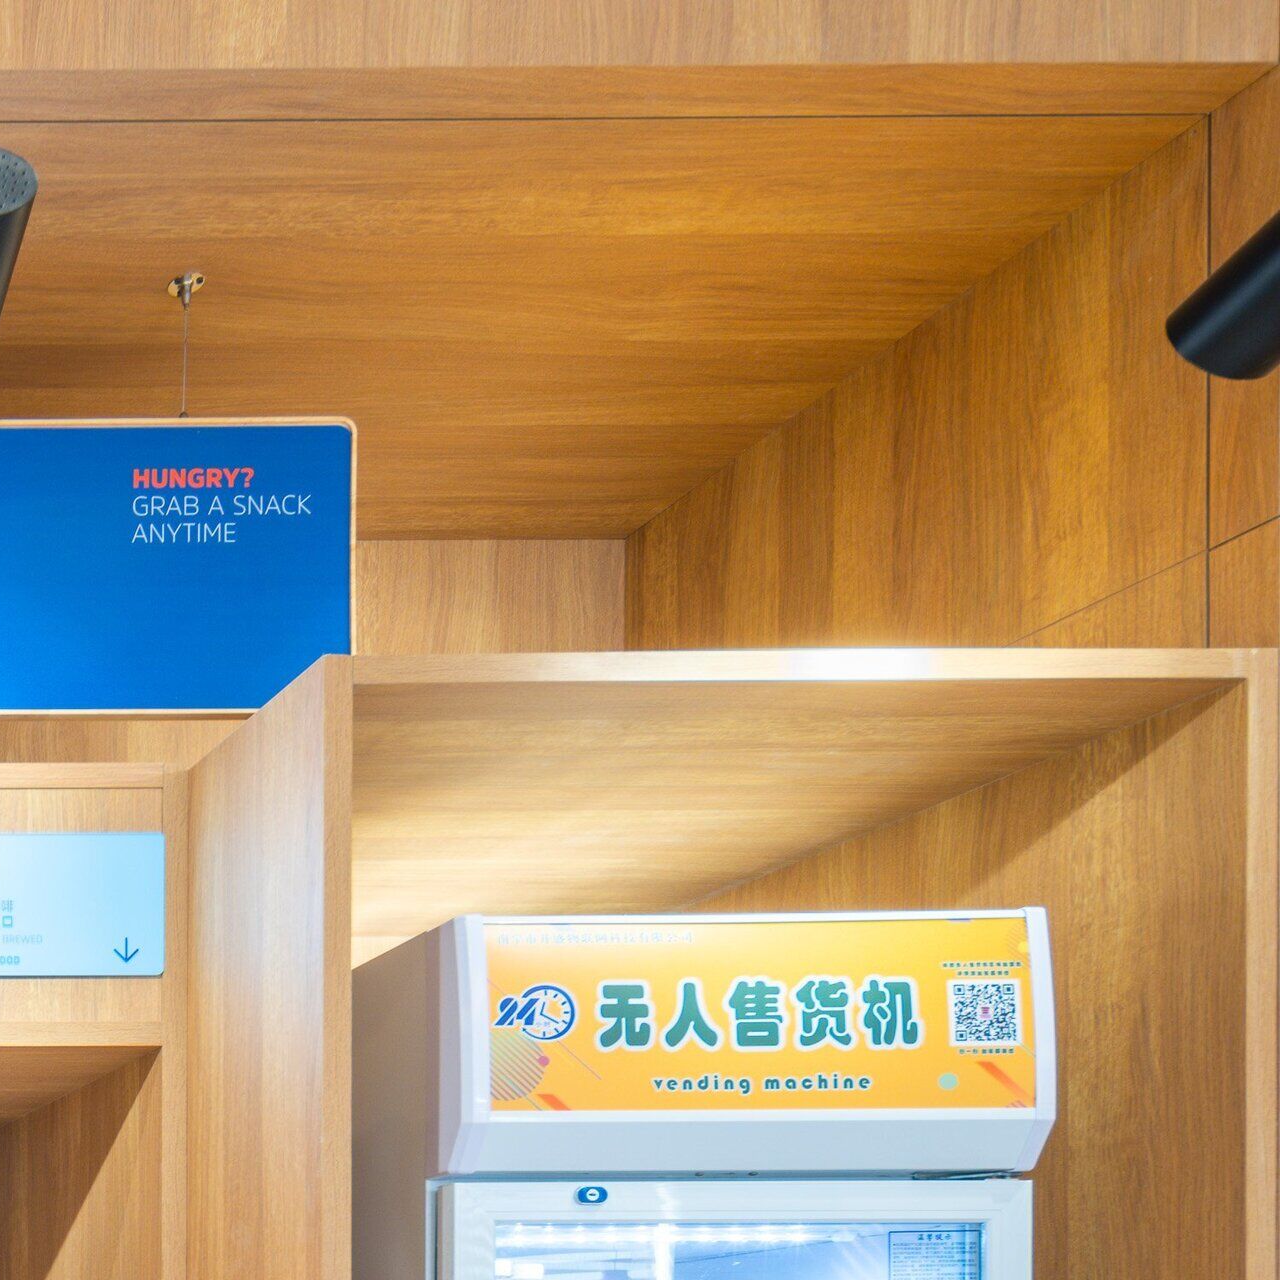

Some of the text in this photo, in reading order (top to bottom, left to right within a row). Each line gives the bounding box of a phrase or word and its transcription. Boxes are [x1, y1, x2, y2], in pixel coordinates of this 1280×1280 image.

[132, 467, 255, 489] HUNGRY?
[131, 495, 312, 516] GRAB A SNACK
[131, 522, 237, 544] ANYTIME
[2, 935, 44, 944] BREWED
[598, 978, 920, 1049] 无人售货机
[652, 1072, 873, 1095] vending machine
